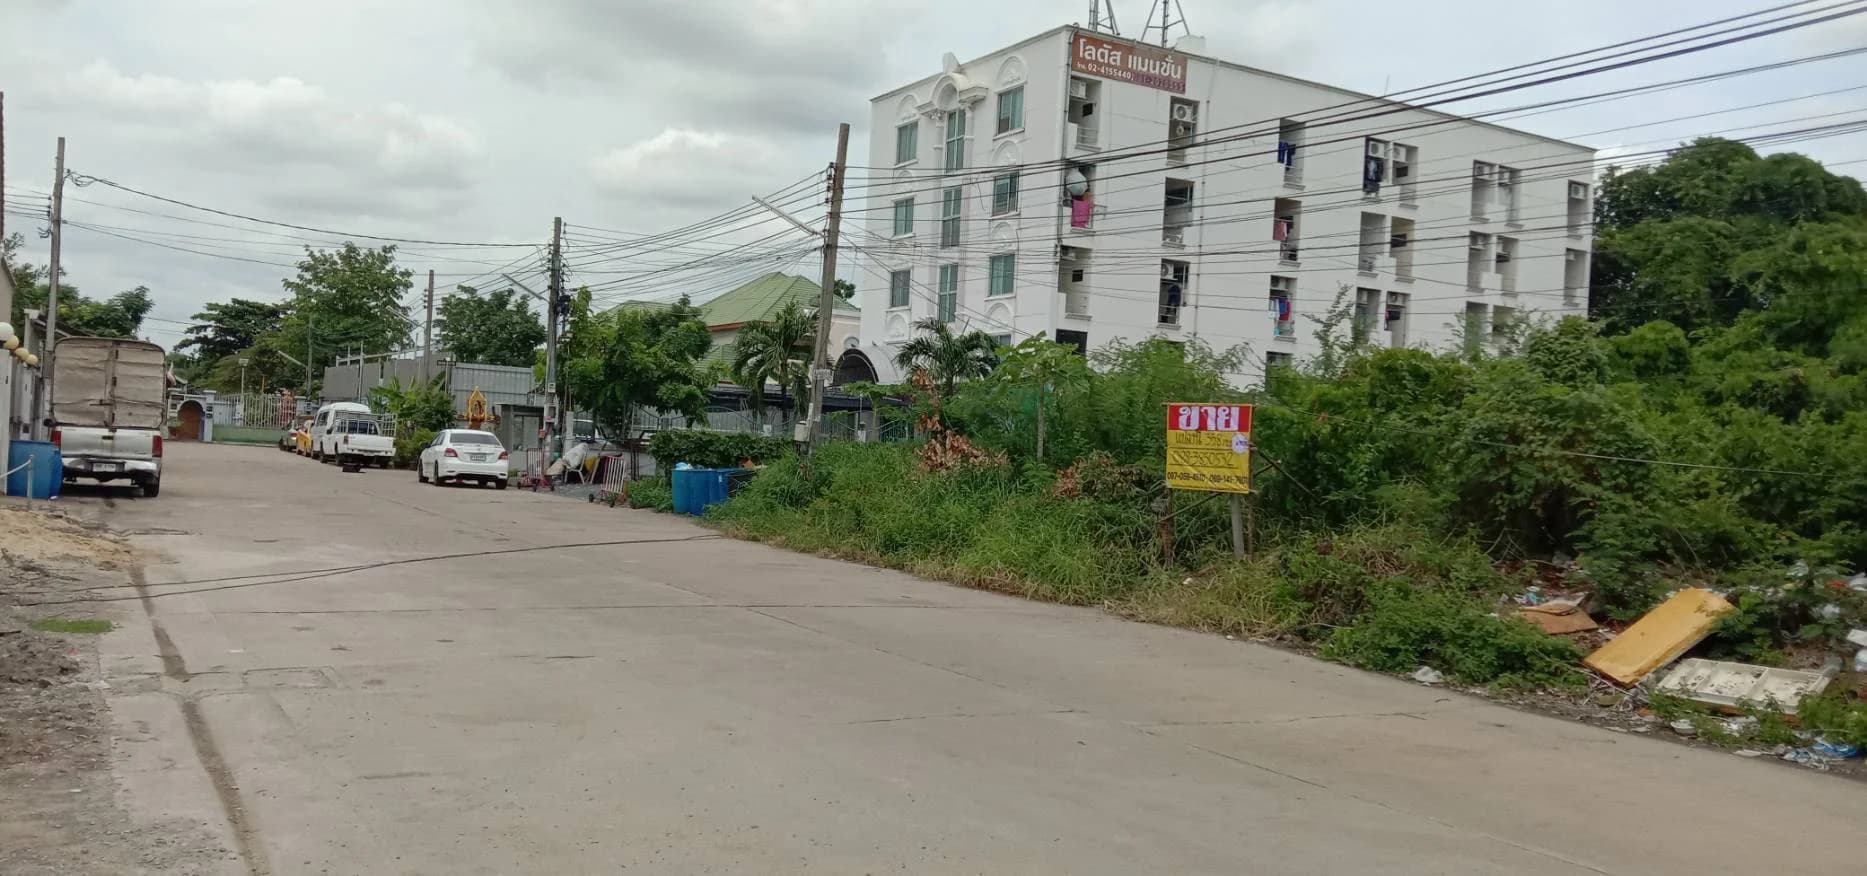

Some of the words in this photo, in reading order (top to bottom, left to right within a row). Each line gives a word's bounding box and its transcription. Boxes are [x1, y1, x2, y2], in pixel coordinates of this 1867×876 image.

[1079, 39, 1122, 67] โลตัส
[1127, 54, 1182, 79] แมนชั่น
[1178, 406, 1240, 431] ขาย
